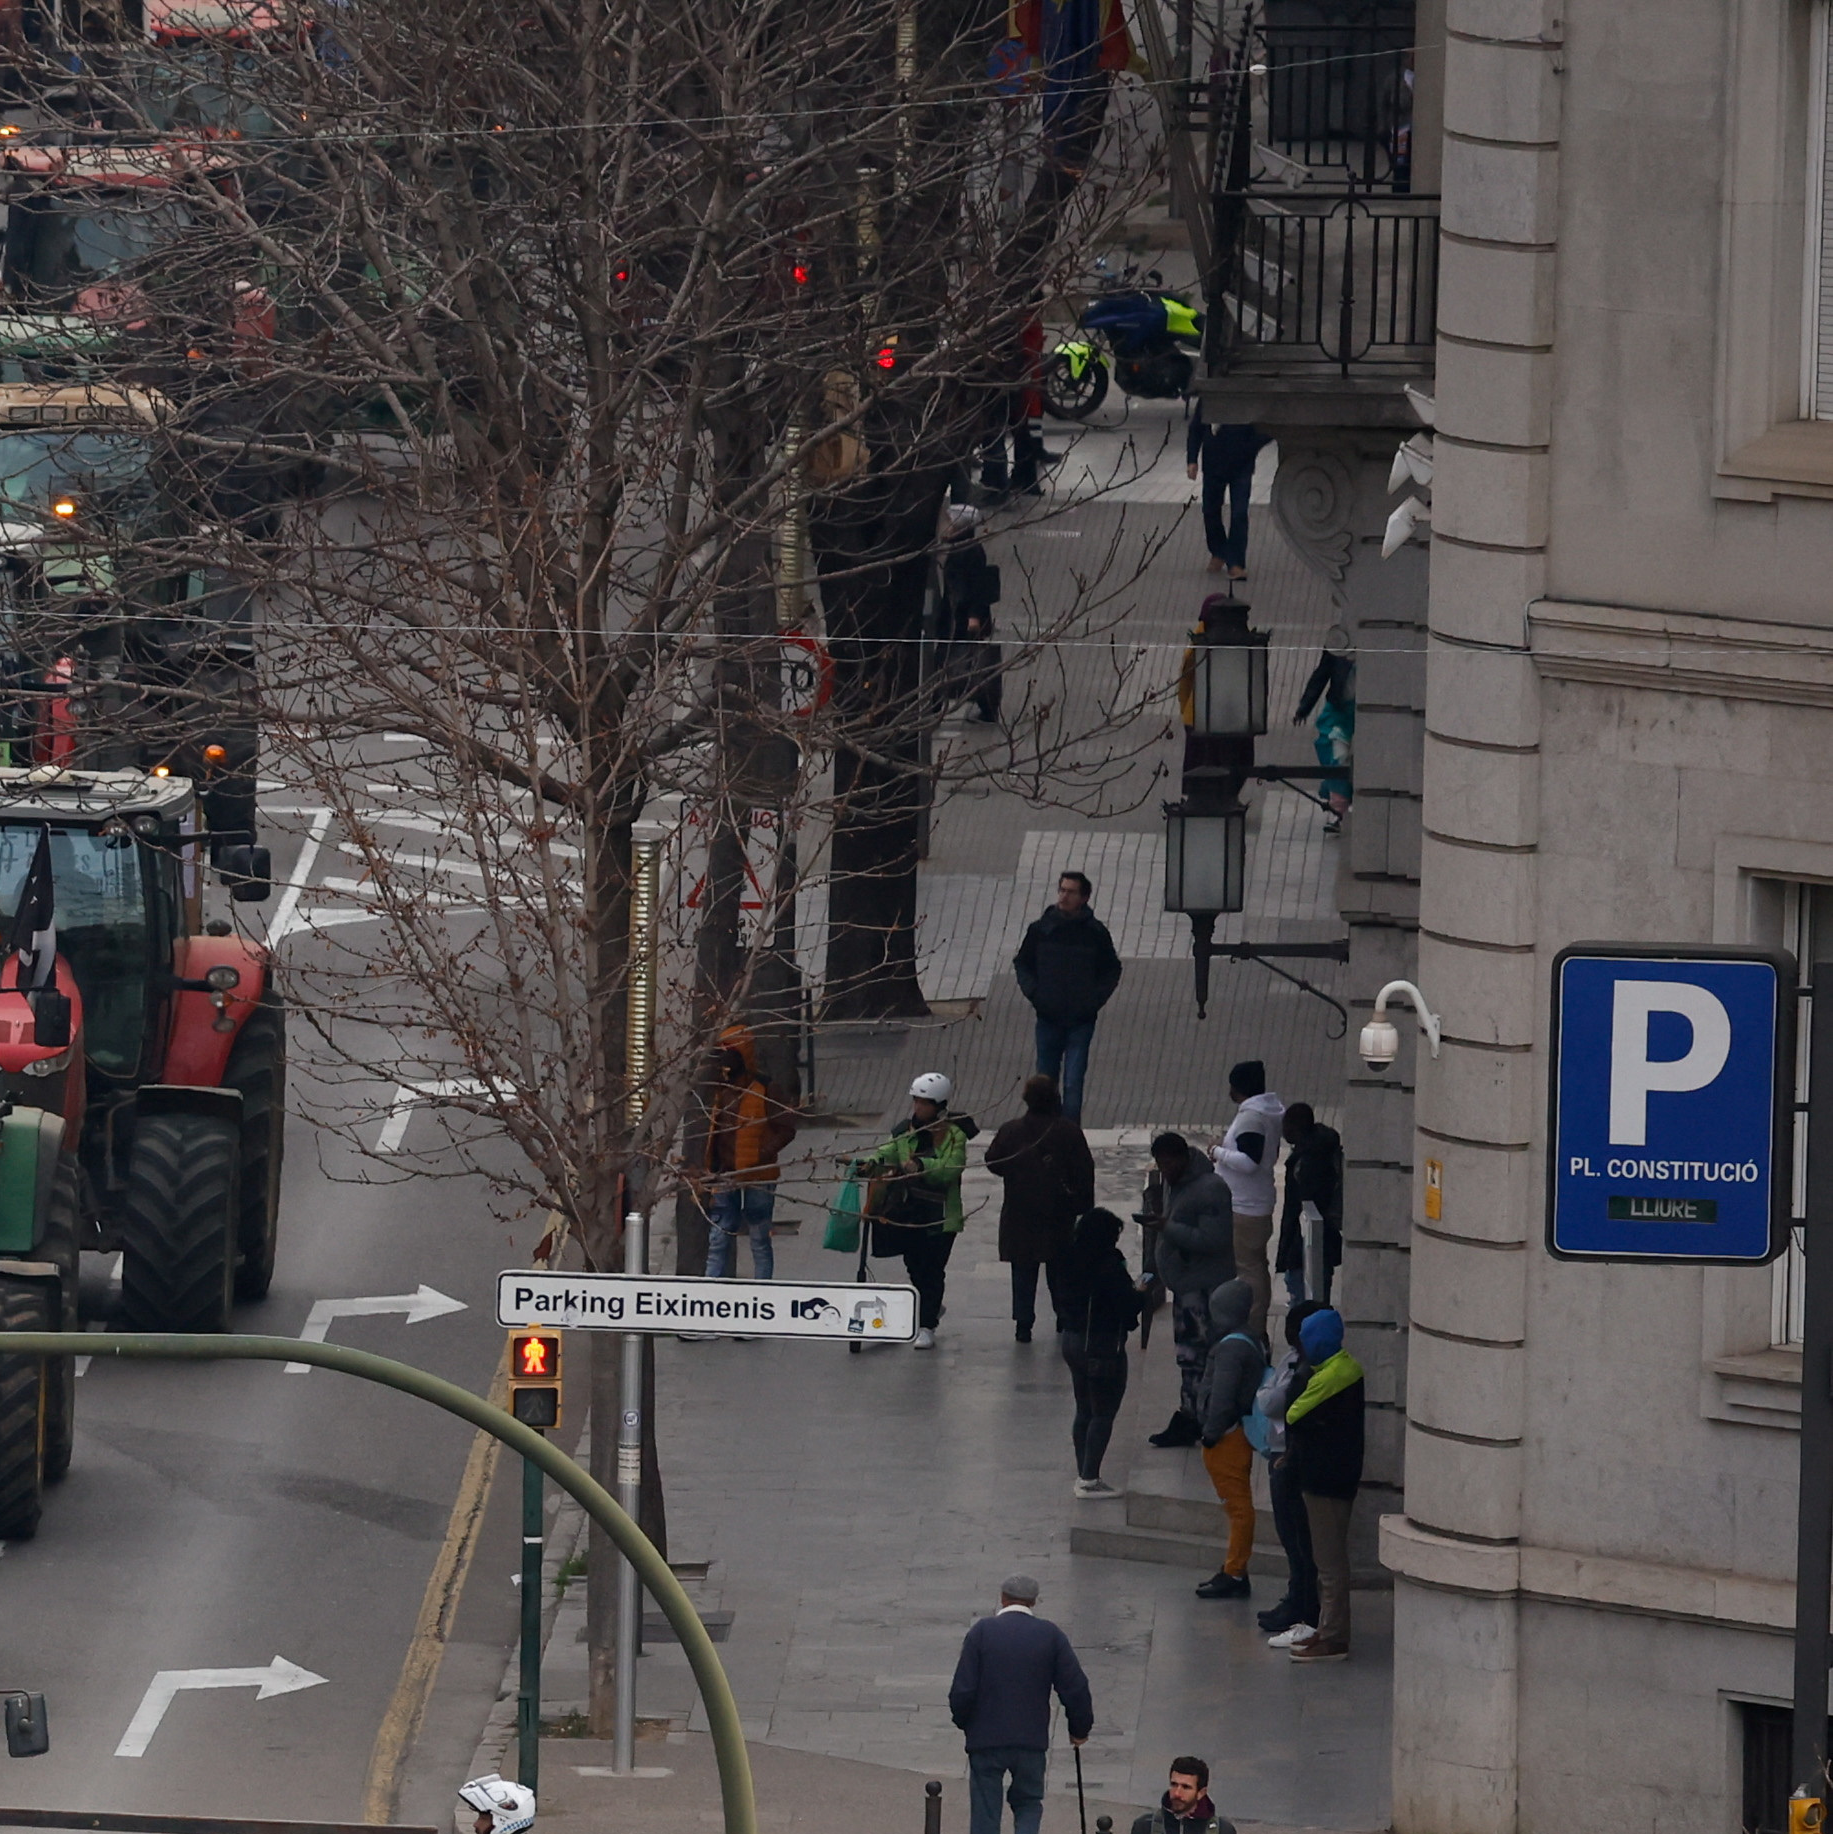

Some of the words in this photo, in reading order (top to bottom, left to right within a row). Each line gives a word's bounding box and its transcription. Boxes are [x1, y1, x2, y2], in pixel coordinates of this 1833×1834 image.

[1608, 979, 1733, 1147] P
[1569, 1156, 1602, 1178] PL.
[1606, 1157, 1760, 1184] CONSTITUCIÓ
[1629, 1197, 1699, 1219] LLIURE
[514, 1287, 625, 1321] Parking
[635, 1291, 776, 1321] Eiximenis
